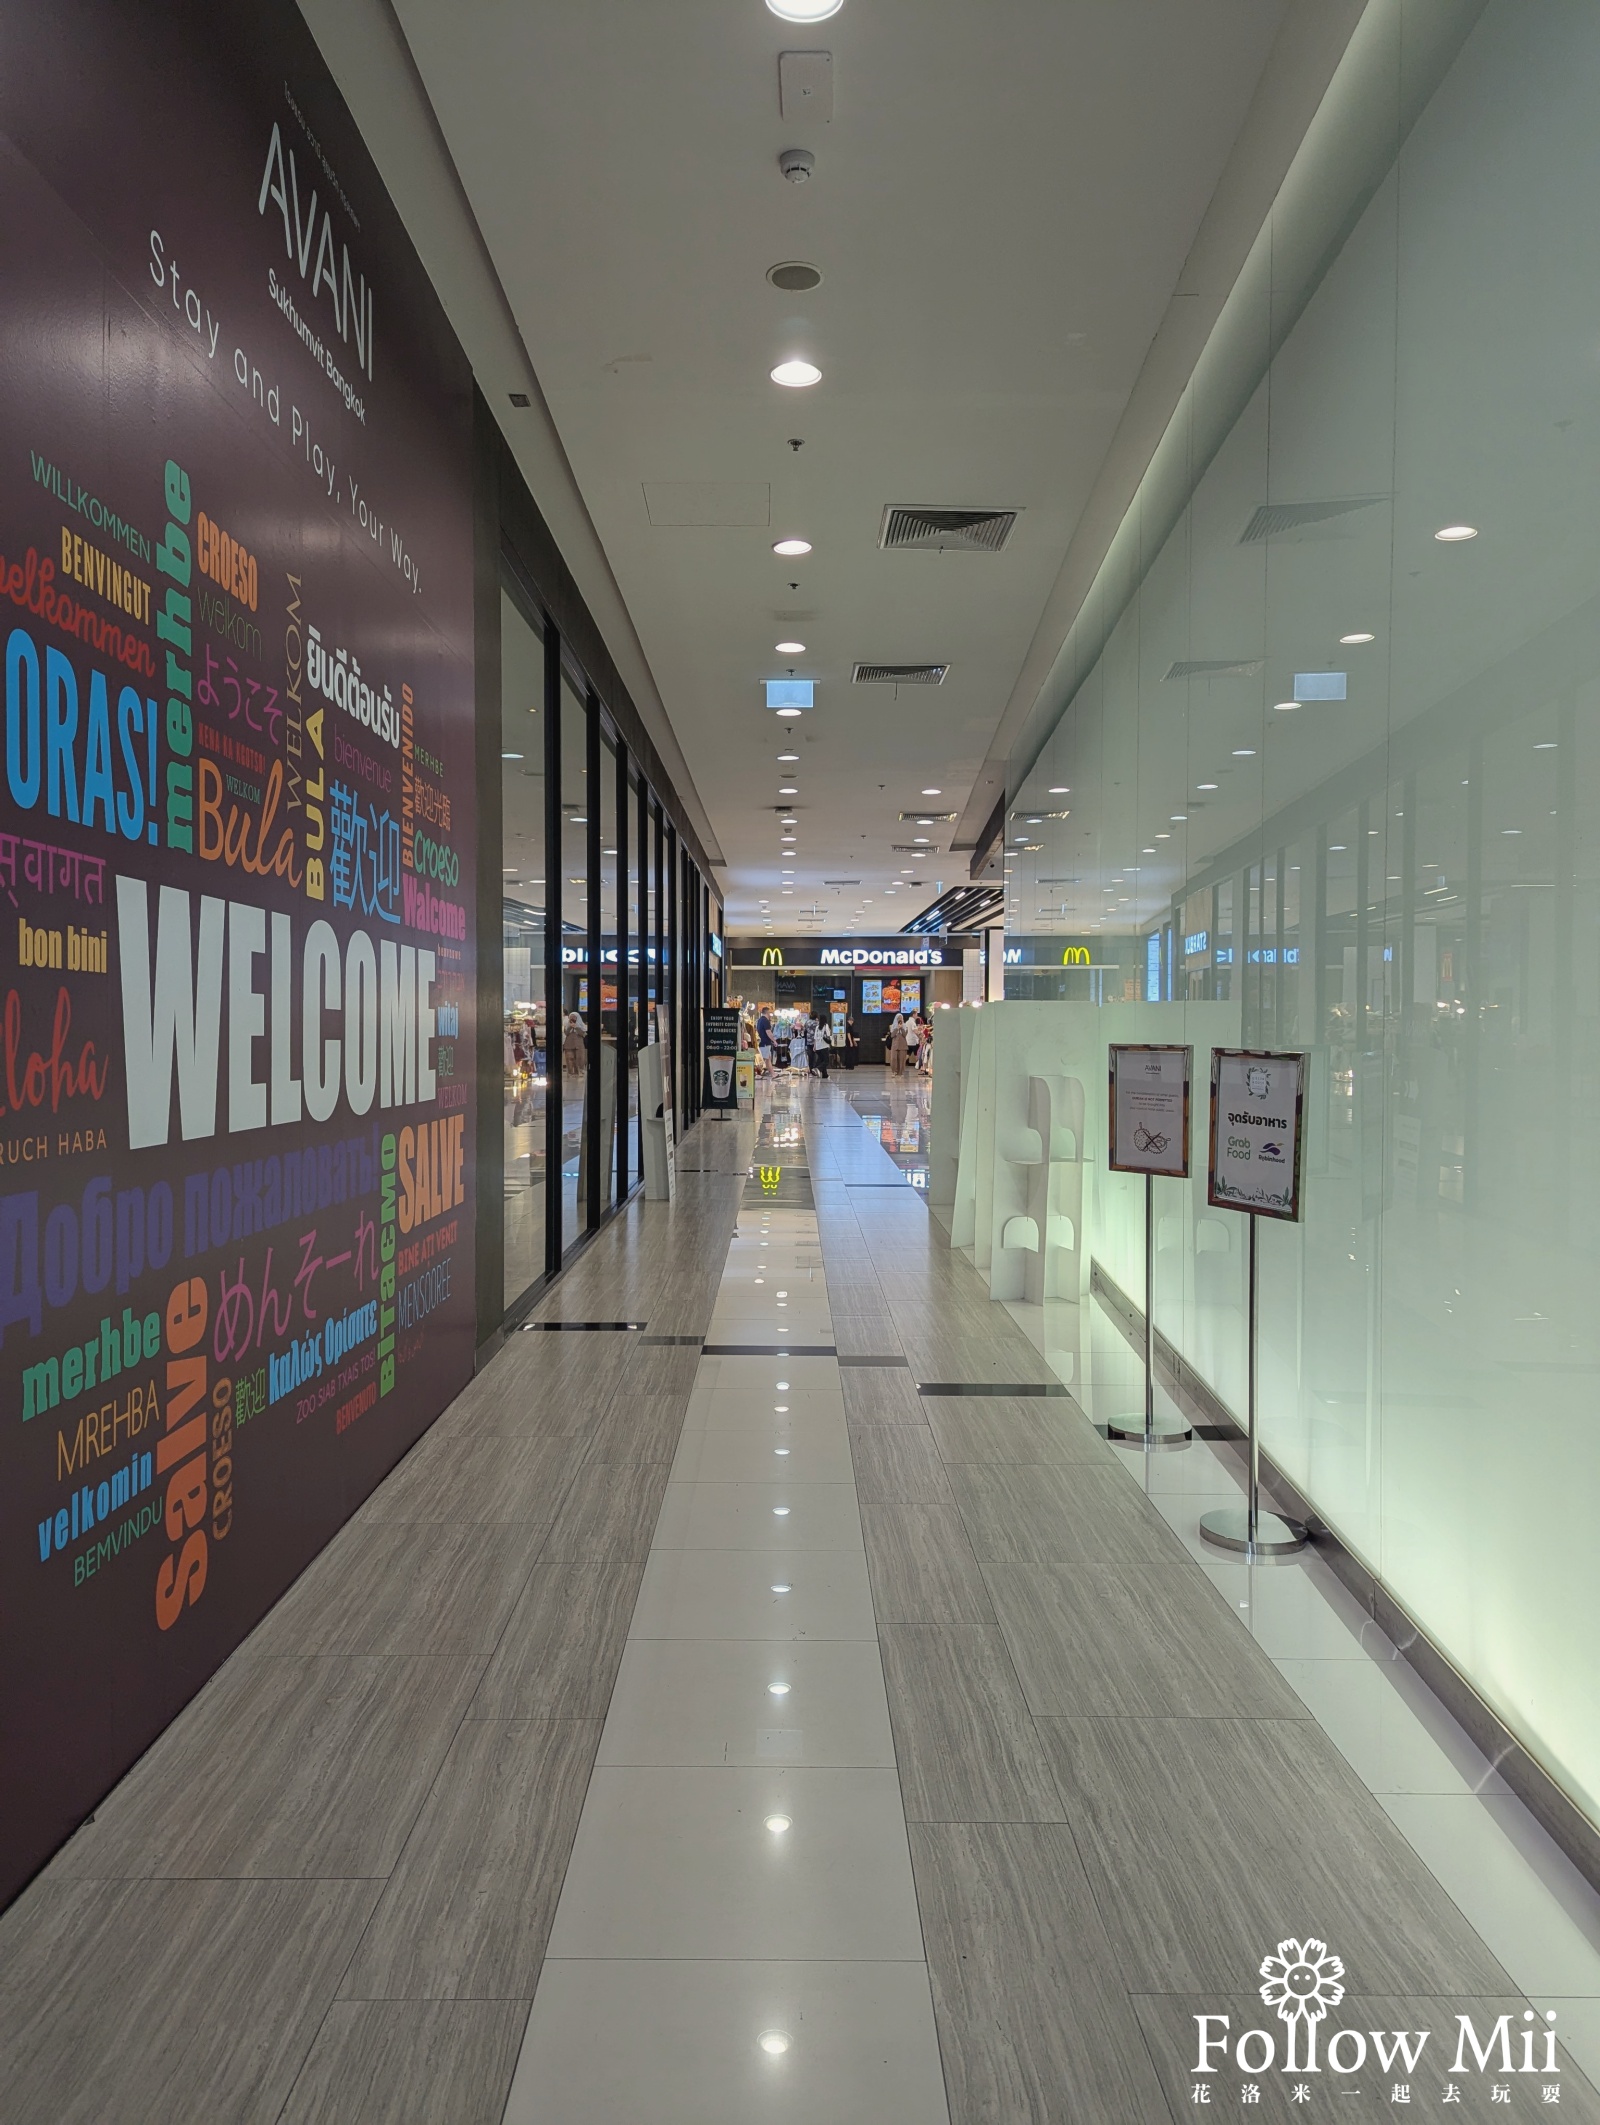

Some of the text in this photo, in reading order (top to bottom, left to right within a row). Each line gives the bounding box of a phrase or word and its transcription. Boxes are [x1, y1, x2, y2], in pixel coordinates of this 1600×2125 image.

[259, 122, 372, 382] AVANI
[268, 268, 324, 368] Sukhumvit
[326, 349, 365, 426] Bangkok
[150, 230, 422, 594] Stay and Play, Your Way.
[30, 450, 151, 564] WILLKOMMEN
[62, 526, 151, 625] BENVINGUT
[198, 511, 258, 613] CROESO
[157, 460, 193, 854] merhbe
[197, 643, 283, 745] ようこそ
[286, 571, 303, 813] WELKOM
[307, 624, 400, 749] ยินดีต้อนรับ
[6, 628, 158, 846] ORAS!
[334, 724, 392, 793] bienvenue
[402, 683, 414, 868] BIENVENIDO
[414, 744, 444, 778] MERHBE
[199, 758, 303, 888] Bula
[226, 774, 261, 805] WELKOM
[305, 708, 325, 901] BULA
[330, 779, 401, 925] 歡迎
[19, 918, 107, 973] bon bini
[820, 949, 942, 965] McDonald's
[0, 987, 108, 1113] loha
[116, 874, 436, 1150] WELCOME
[438, 1001, 459, 1040] witaj
[437, 1083, 468, 1110] WELKOM
[1144, 1064, 1162, 1072] AVANI
[58, 1127, 107, 1157] HABA
[1226, 1147, 1251, 1161] Food
[1227, 1110, 1288, 1129] จุดรับอาหาร
[1227, 1135, 1251, 1149] Grab
[1258, 1154, 1286, 1164] Robinhood
[399, 1113, 466, 1234] SALVE
[0, 1122, 380, 1352] Добро пожаловать!
[214, 1210, 380, 1362] めんそーれ
[398, 1241, 420, 1277] BINE
[435, 1220, 458, 1252] VENIT
[398, 1257, 452, 1334] MENSOOREE
[22, 1307, 161, 1422] merhbe
[235, 1367, 266, 1429] 歡迎
[295, 1393, 316, 1425] ZOO
[318, 1380, 336, 1408] SIAB
[338, 1362, 359, 1393] TXAIS
[336, 1381, 377, 1435] BENVENUTO
[57, 1380, 160, 1481] MREHBA
[212, 1377, 233, 1541] CROESO
[38, 1450, 152, 1562] velkomin
[74, 1496, 163, 1587] BEMVINDU
